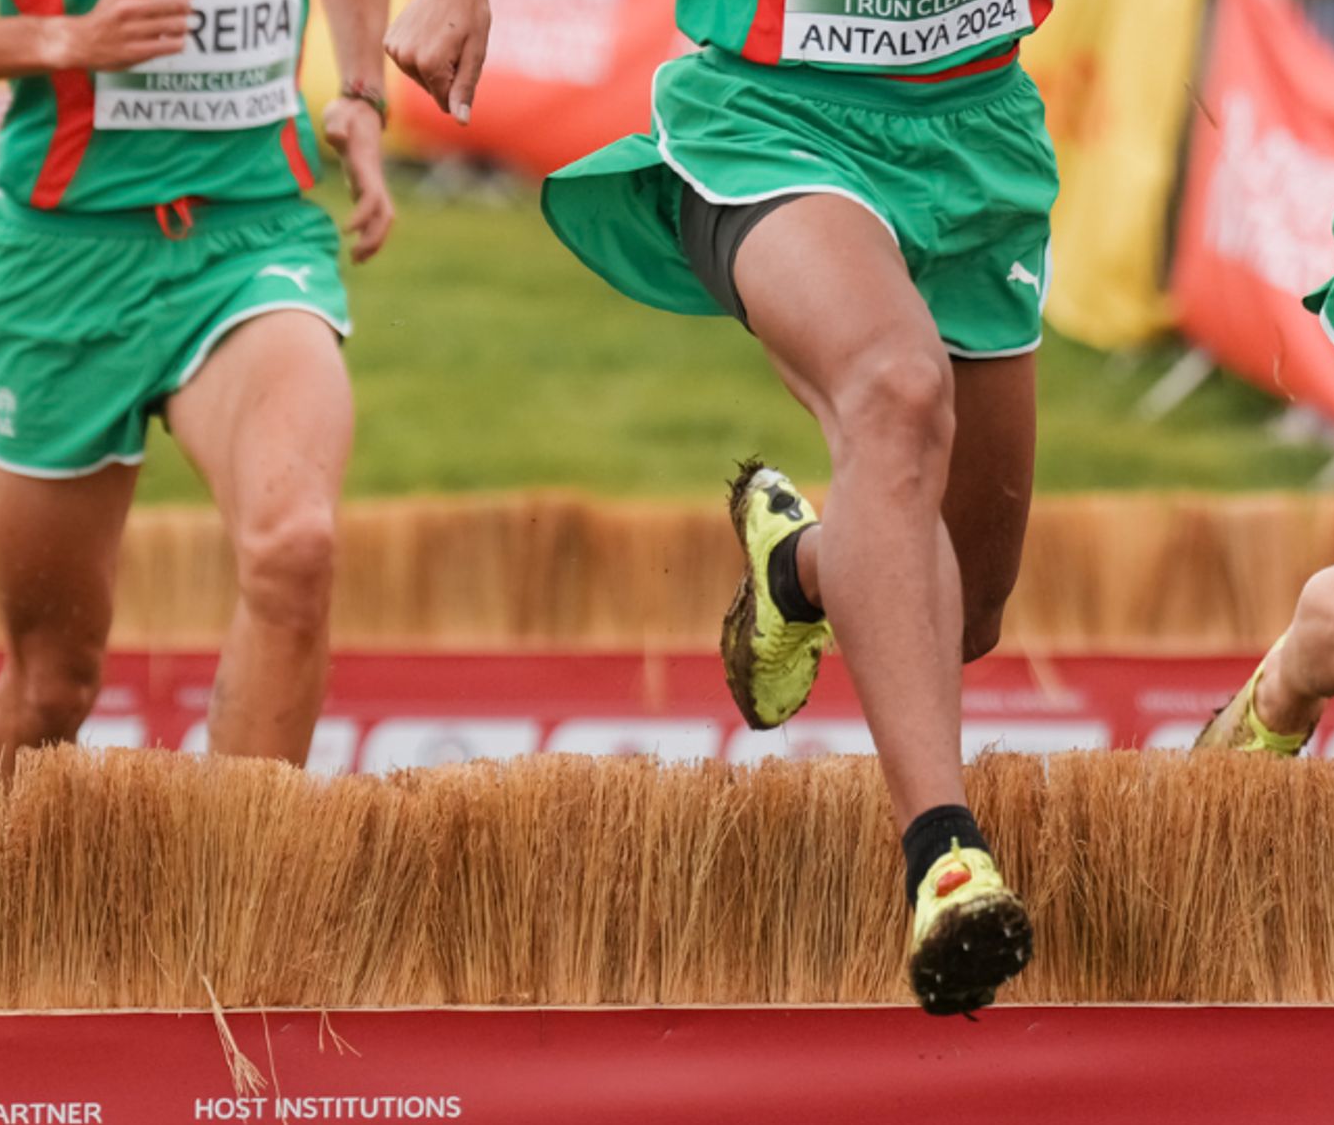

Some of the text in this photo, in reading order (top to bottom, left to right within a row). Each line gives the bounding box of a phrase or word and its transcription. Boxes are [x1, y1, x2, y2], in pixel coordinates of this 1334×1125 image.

[800, 24, 949, 56] ANTALYA
[157, 74, 203, 91] RUN
[206, 68, 266, 91] CLEAN
[110, 99, 239, 122] ANTALYA
[194, 1096, 462, 1119] HOST INSTITUTIONS
